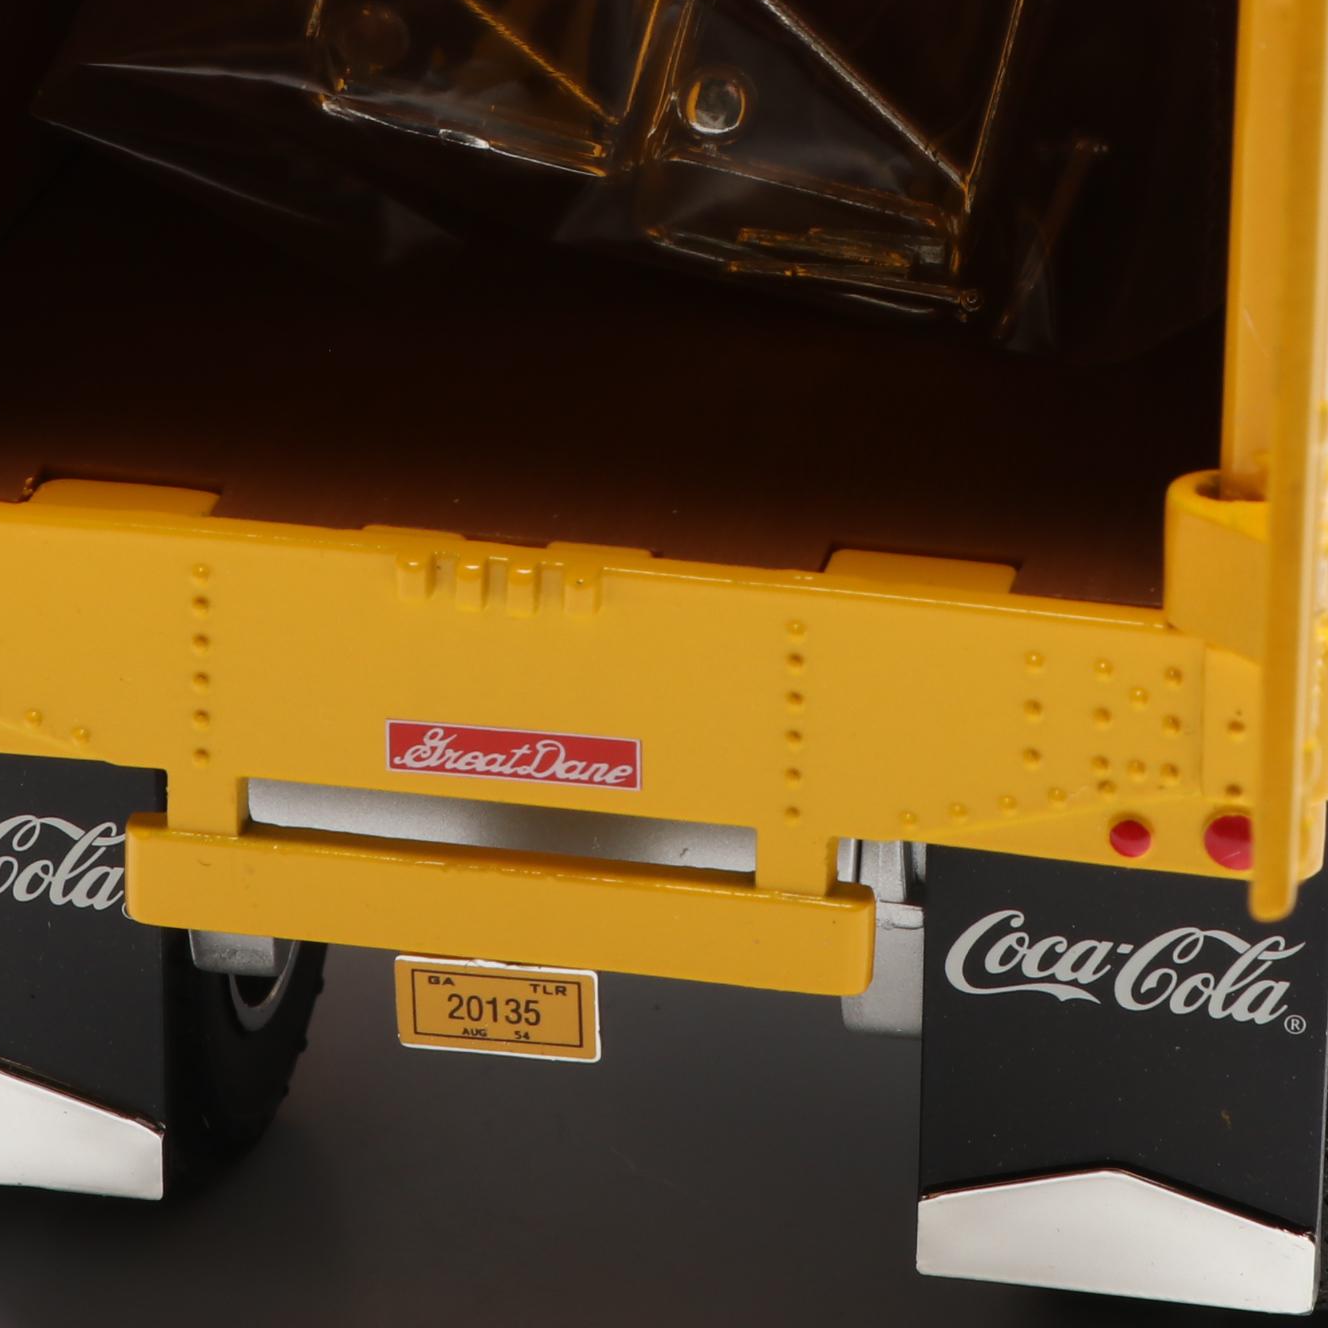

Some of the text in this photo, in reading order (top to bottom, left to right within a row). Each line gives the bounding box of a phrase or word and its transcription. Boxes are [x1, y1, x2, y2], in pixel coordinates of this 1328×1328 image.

[944, 909, 1306, 1026] Coca-Cola
[427, 975, 567, 996] GA TLR
[447, 993, 541, 1026] 20135
[461, 1028, 530, 1041] AUG 54
